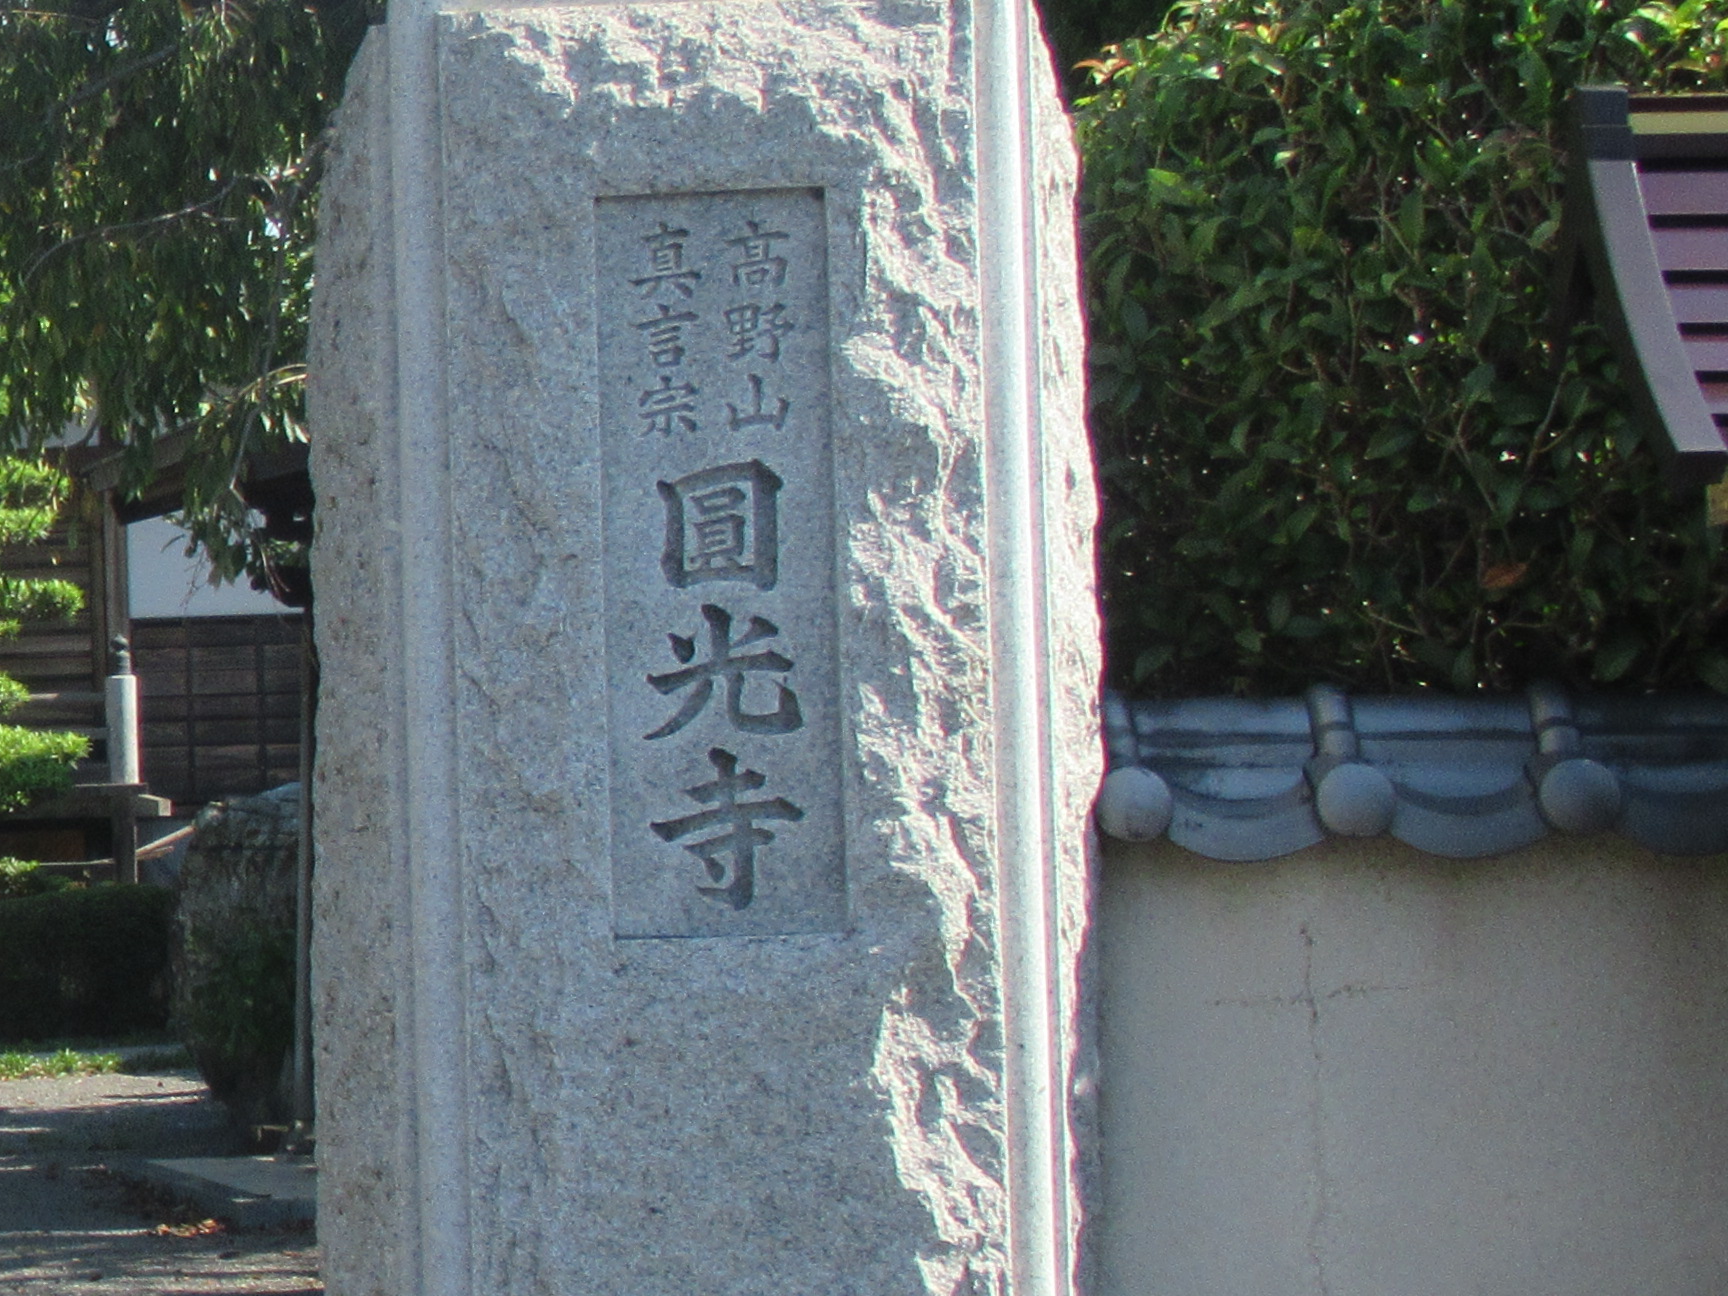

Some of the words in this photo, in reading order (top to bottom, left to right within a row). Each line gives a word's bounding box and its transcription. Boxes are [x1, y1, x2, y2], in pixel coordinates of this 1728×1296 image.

[628, 221, 702, 439] 真言宗
[644, 459, 805, 911] 圓光寺
